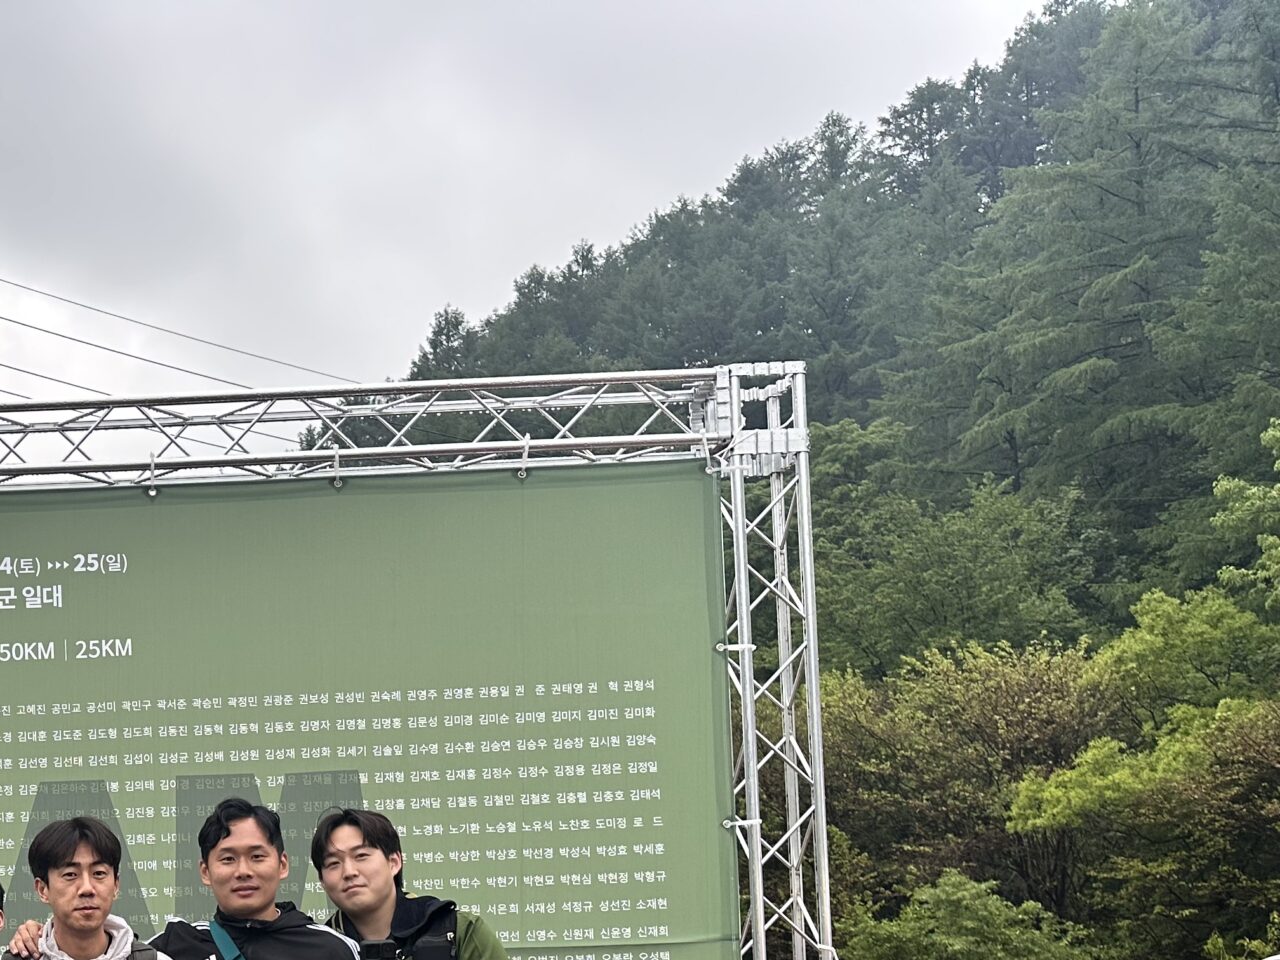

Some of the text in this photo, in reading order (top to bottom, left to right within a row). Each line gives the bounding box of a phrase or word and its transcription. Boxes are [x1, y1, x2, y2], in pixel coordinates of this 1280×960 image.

[73, 552, 128, 575] 25(일)
[21, 584, 63, 609] 일대
[74, 638, 133, 659] 25KM
